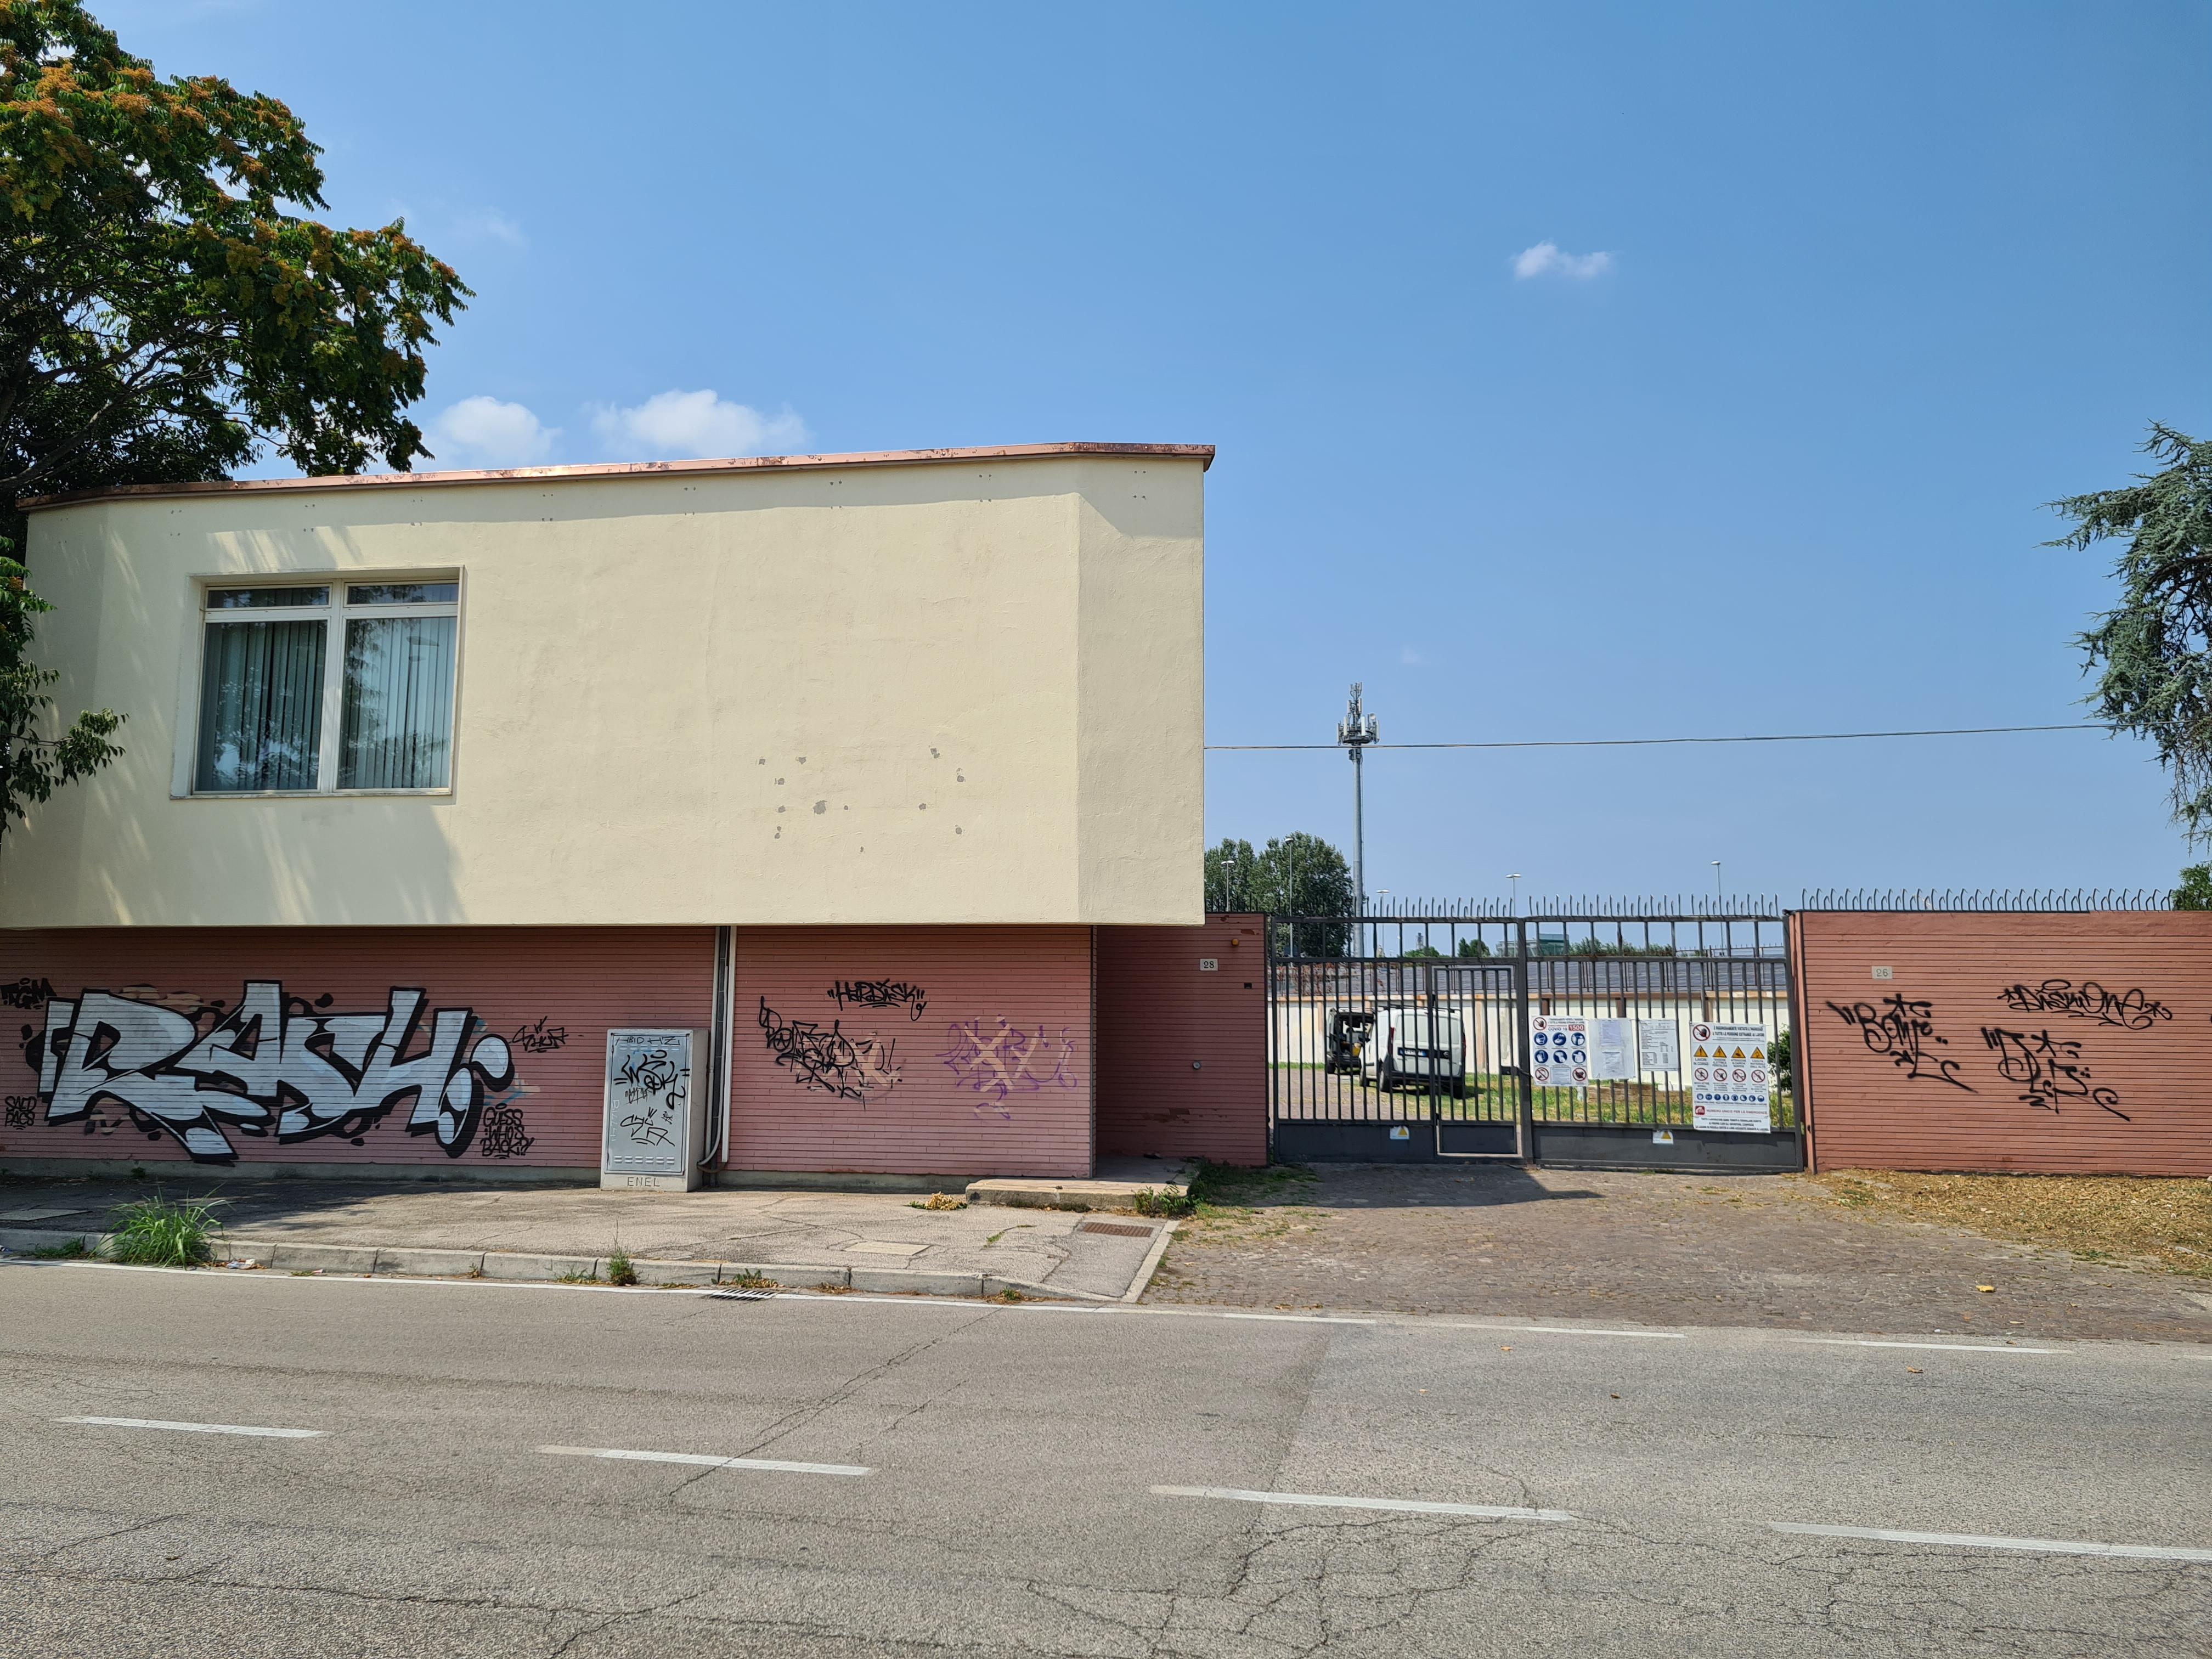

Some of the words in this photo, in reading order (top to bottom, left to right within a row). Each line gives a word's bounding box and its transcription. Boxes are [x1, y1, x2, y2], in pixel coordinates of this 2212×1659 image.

[1203, 961, 1215, 969] 28
[1876, 968, 1888, 977] 26
[483, 1107, 524, 1127] GUESS
[627, 1177, 661, 1187] ENEL
